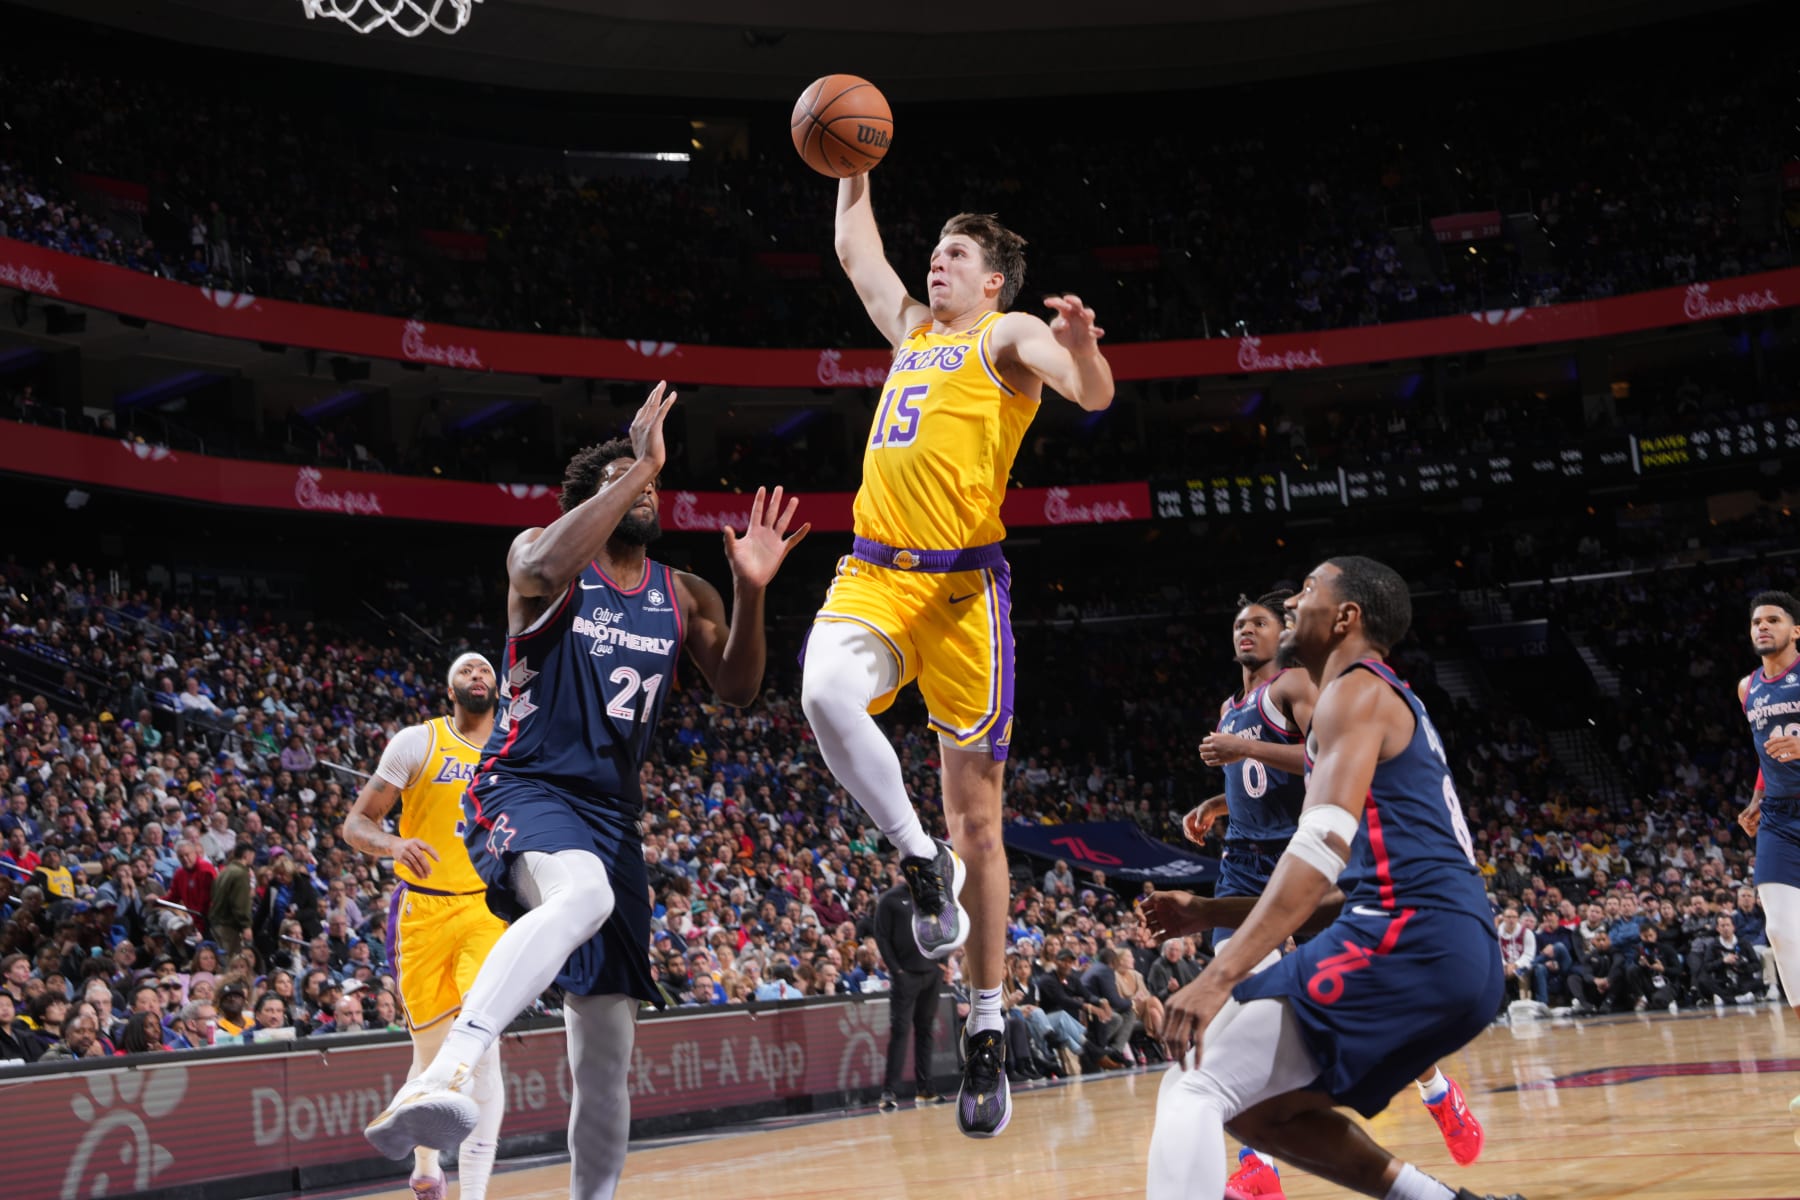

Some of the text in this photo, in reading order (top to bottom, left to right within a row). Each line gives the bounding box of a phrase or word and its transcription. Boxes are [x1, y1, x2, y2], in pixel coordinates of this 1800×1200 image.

[888, 345, 970, 376] AKERS
[870, 384, 930, 450] 15
[1639, 434, 1687, 452] PLAYER
[1642, 449, 1690, 467] POINTS
[593, 607, 624, 625] City of
[572, 616, 675, 655] BROTHERLY
[589, 639, 614, 657] Love
[606, 666, 663, 723] 21
[432, 756, 477, 783] LAK
[1242, 757, 1268, 798] 0
[252, 1073, 393, 1146] Downl
[501, 1060, 547, 1113] he
[747, 1036, 805, 1092] App
